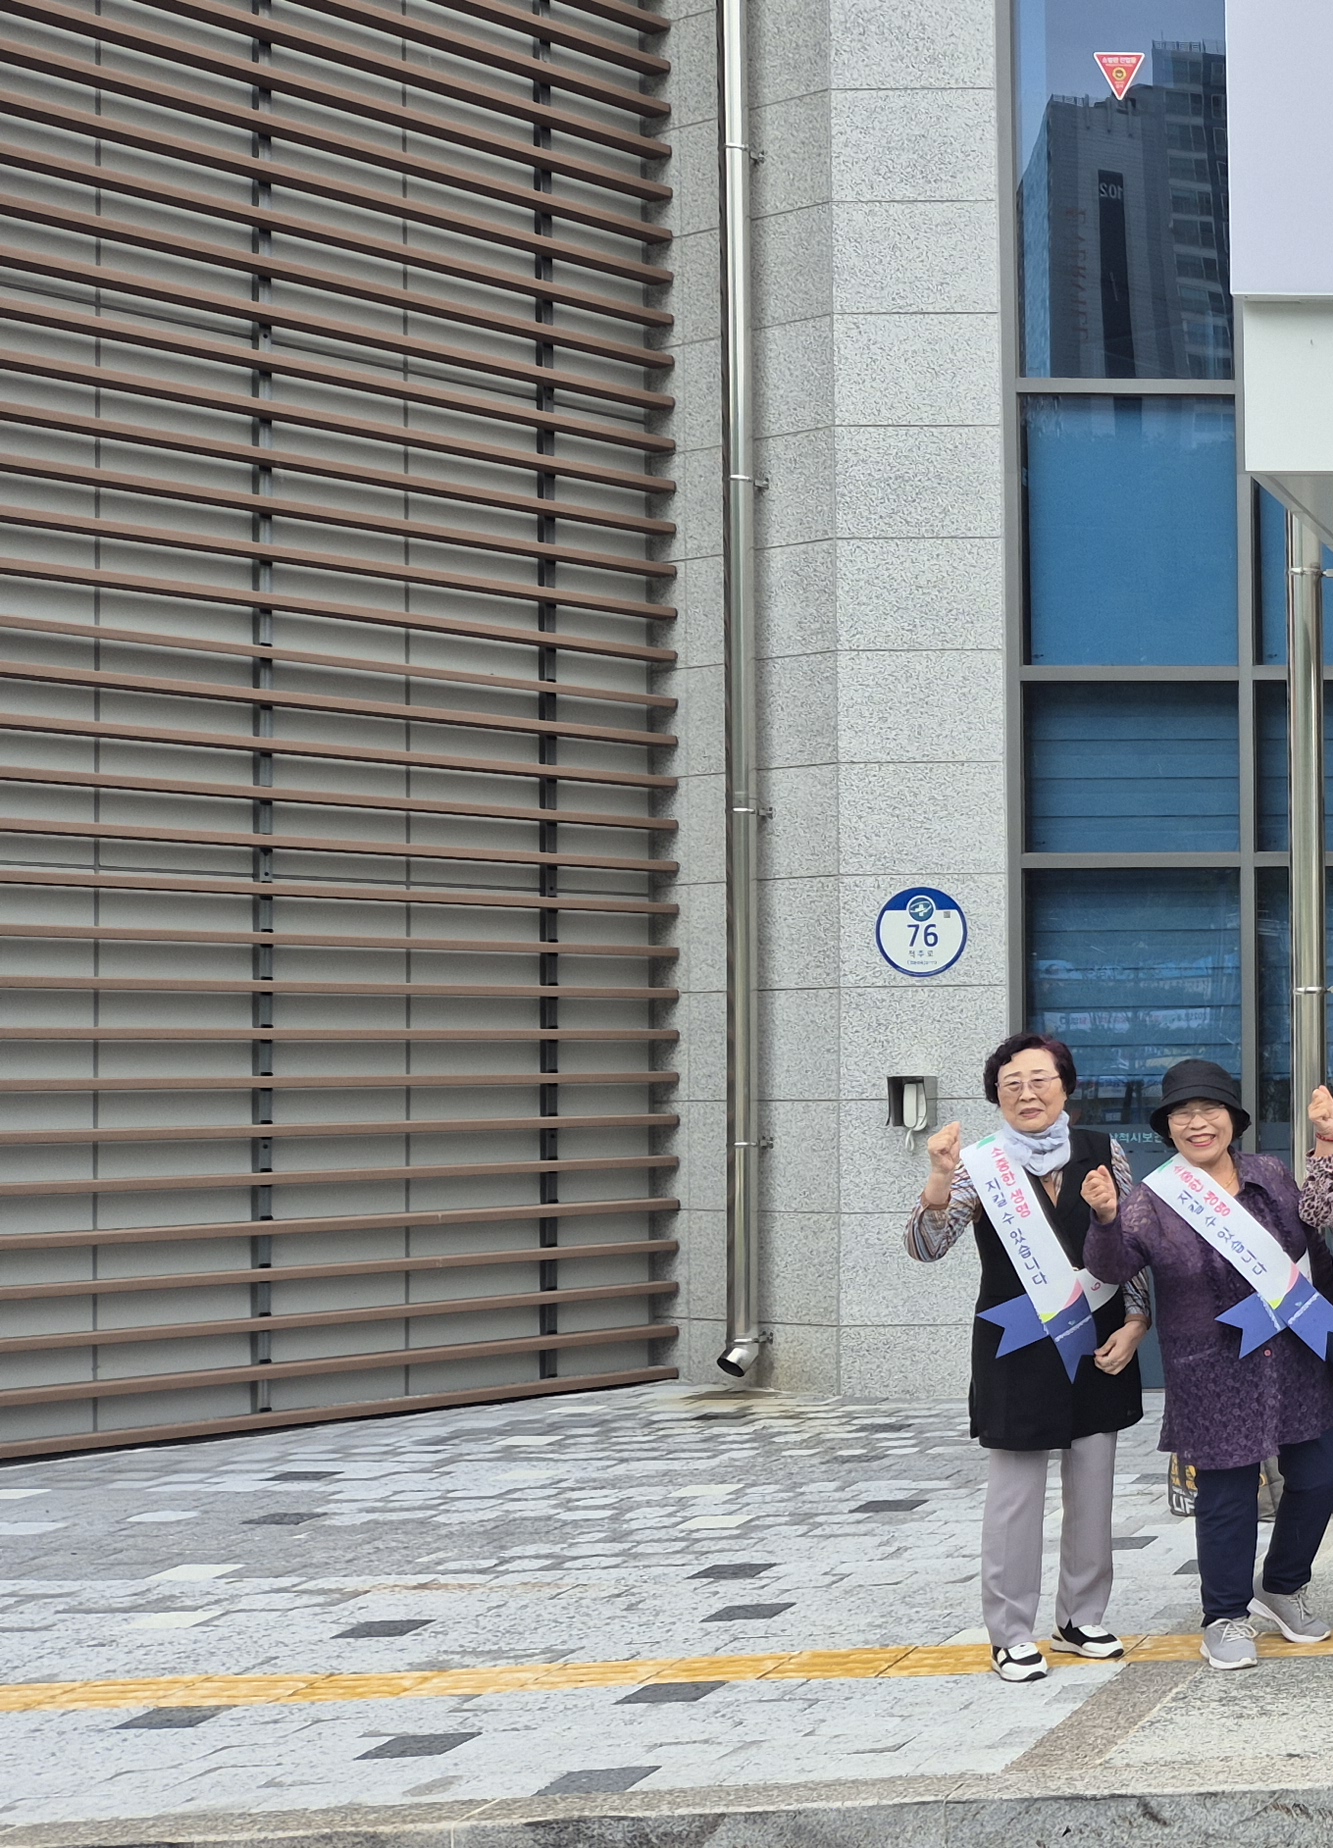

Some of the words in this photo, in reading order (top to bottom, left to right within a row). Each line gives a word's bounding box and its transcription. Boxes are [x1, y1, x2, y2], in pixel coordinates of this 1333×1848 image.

[907, 924, 938, 947] 76
[991, 1146, 1016, 1187] 소중한
[1010, 1188, 1031, 1219] 생명
[1174, 1165, 1204, 1193] 소중한
[1203, 1190, 1231, 1217] 생명
[985, 1177, 1008, 1208] 지킬
[1002, 1211, 1015, 1225] 수
[1009, 1228, 1048, 1285] 있습니다
[1177, 1190, 1204, 1215] 지킬
[1205, 1215, 1217, 1227] 수
[1217, 1227, 1267, 1276] 있습니다
[1172, 1494, 1196, 1514] LIF
